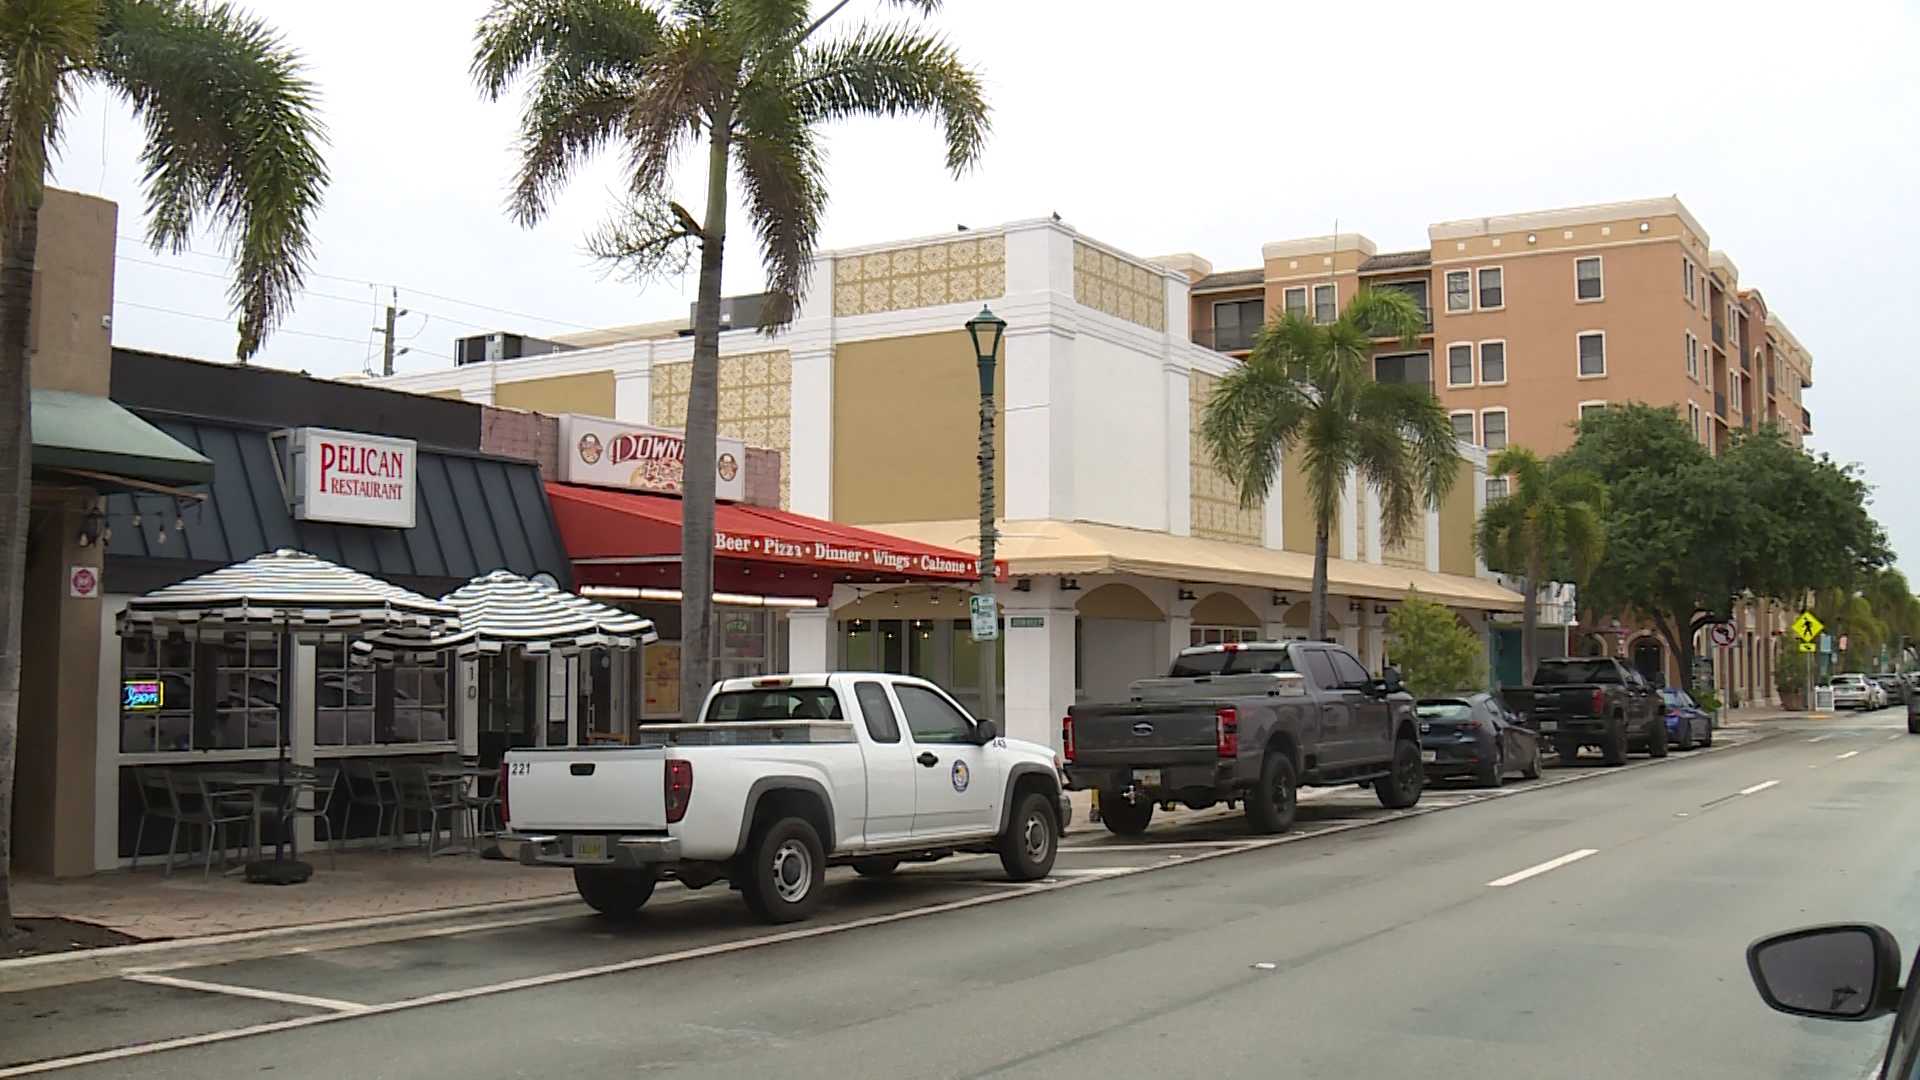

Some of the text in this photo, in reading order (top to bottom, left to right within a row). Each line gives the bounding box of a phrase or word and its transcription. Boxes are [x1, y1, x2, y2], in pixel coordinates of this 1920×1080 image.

[320, 443, 404, 492] PELICAN
[331, 478, 403, 500] RESTAURANT
[715, 533, 751, 552] Beer
[763, 537, 802, 558] Pizza
[814, 543, 862, 563] Dinner
[872, 549, 910, 571] Wings
[920, 555, 966, 574] Calzone
[511, 762, 530, 776] 221
